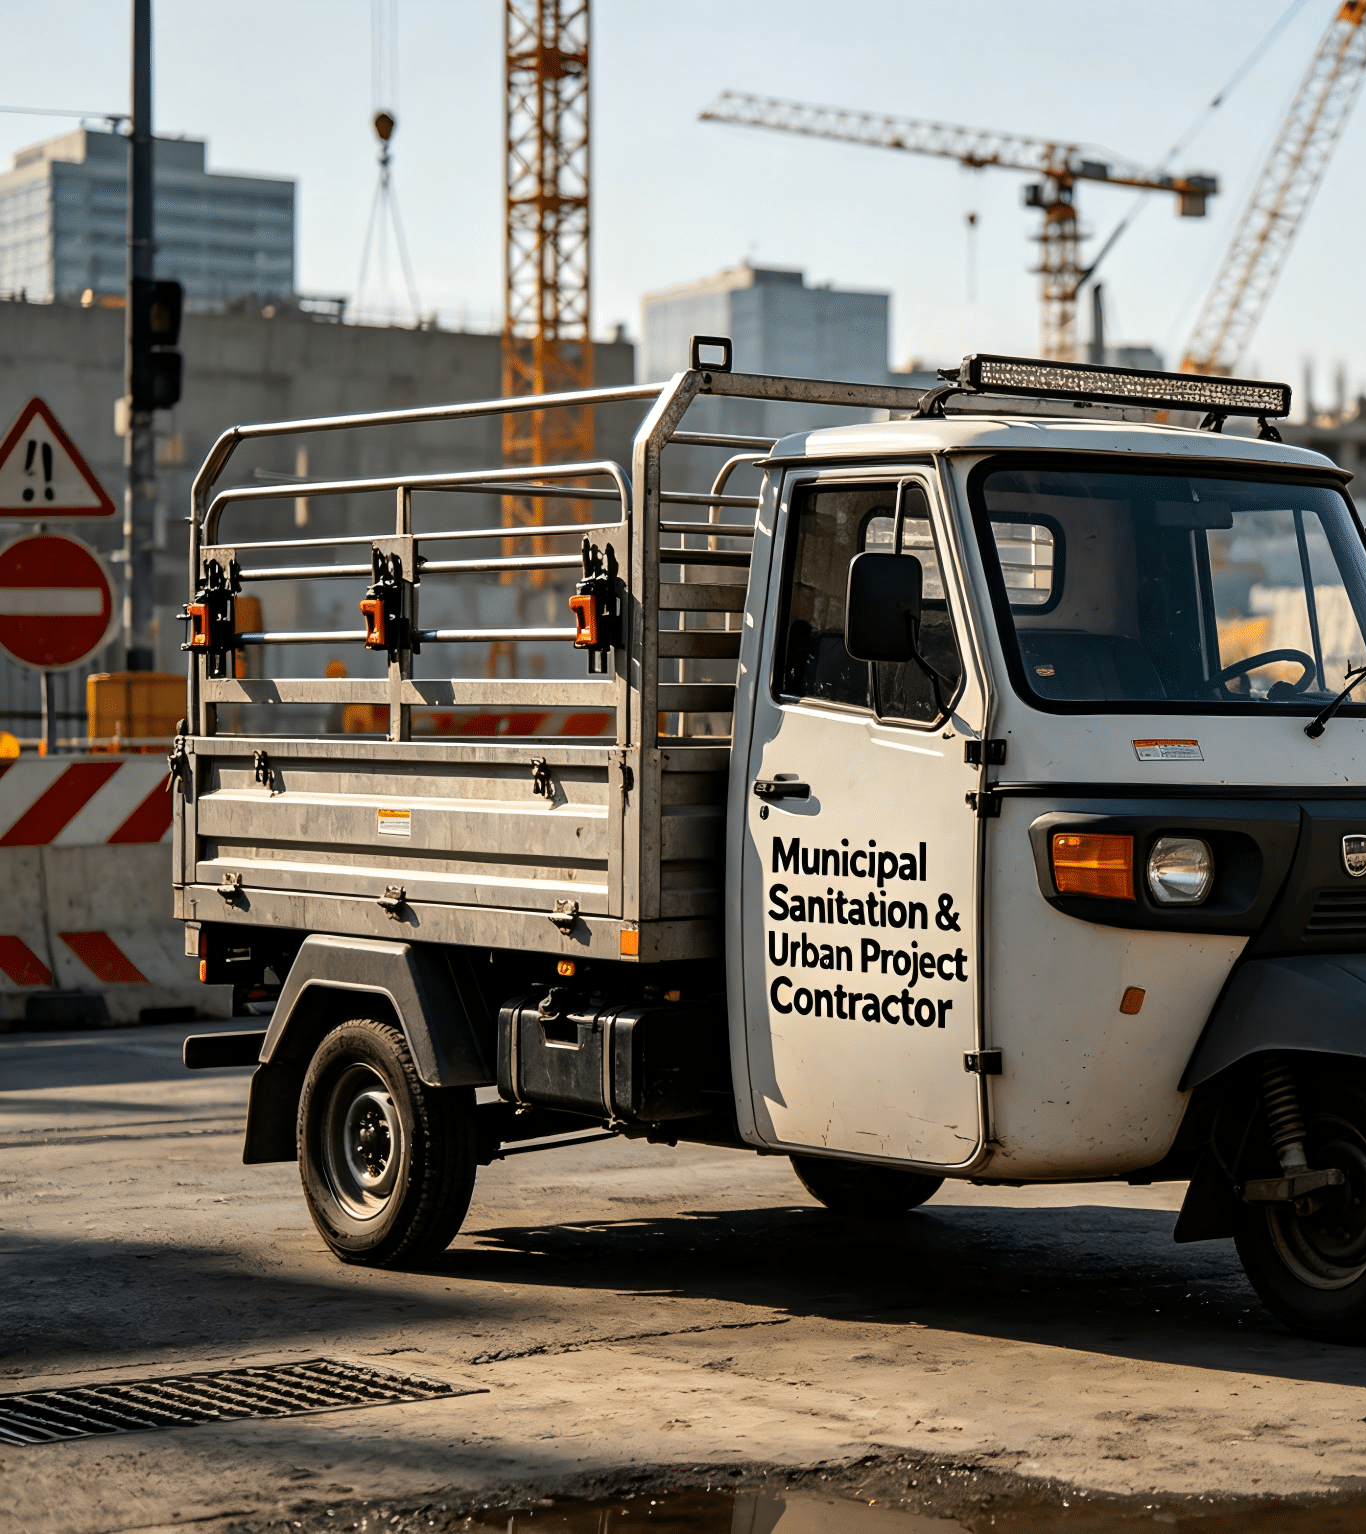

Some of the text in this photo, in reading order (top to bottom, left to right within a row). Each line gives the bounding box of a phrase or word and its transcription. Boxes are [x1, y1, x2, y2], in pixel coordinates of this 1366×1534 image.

[772, 837, 926, 888] Municipal
[768, 883, 961, 932] Sanitation &
[768, 931, 968, 988] Urban Project
[770, 976, 953, 1029] Contractor
